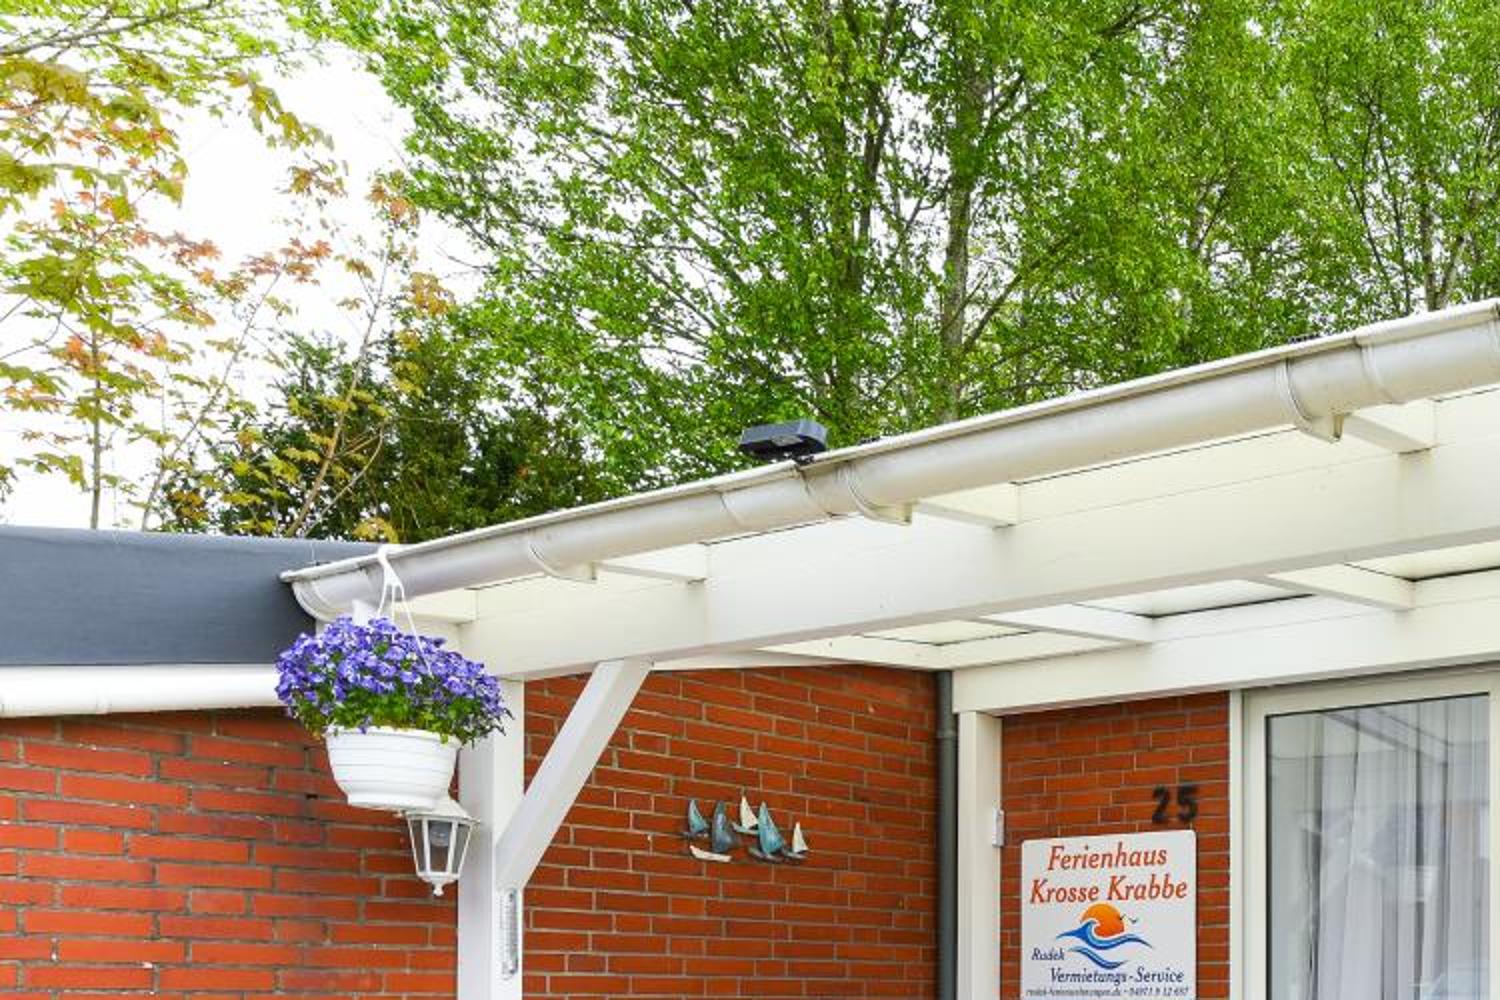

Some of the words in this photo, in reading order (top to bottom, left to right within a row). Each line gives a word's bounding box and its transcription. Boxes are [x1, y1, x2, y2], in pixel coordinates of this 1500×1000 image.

[1152, 785, 1198, 823] 25
[1047, 841, 1168, 871] Ferienhaus
[1030, 879, 1099, 904] Krosse
[1107, 874, 1188, 900] Krabbe
